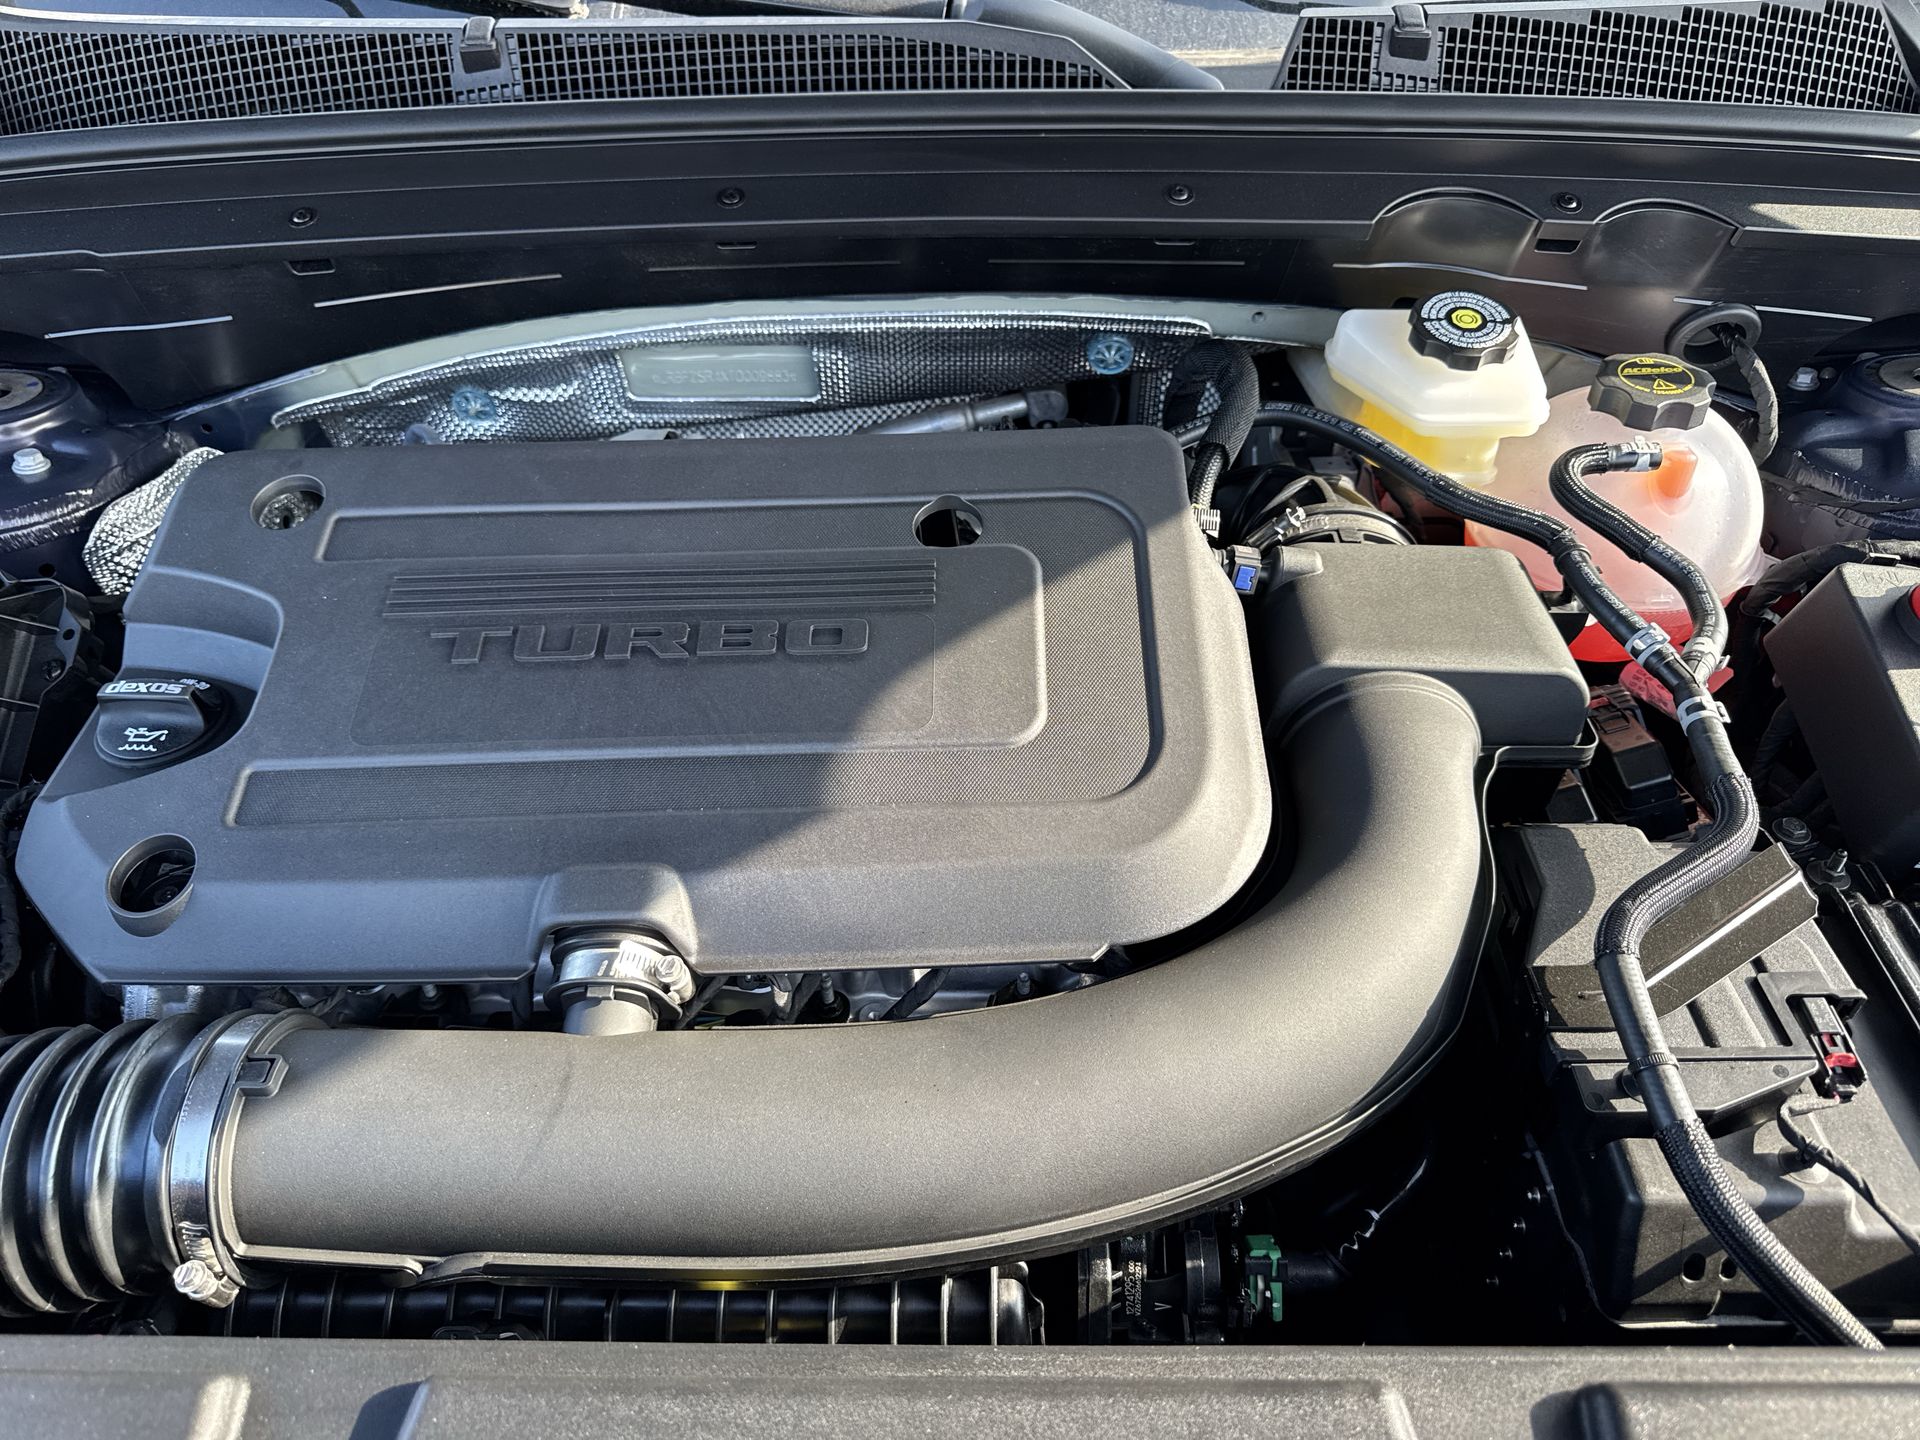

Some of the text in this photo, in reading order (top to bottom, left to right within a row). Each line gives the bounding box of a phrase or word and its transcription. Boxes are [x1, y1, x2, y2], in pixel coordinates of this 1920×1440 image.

[1622, 367, 1683, 375] ACDelco
[430, 618, 869, 665] TURBO
[105, 680, 187, 694] dexos
